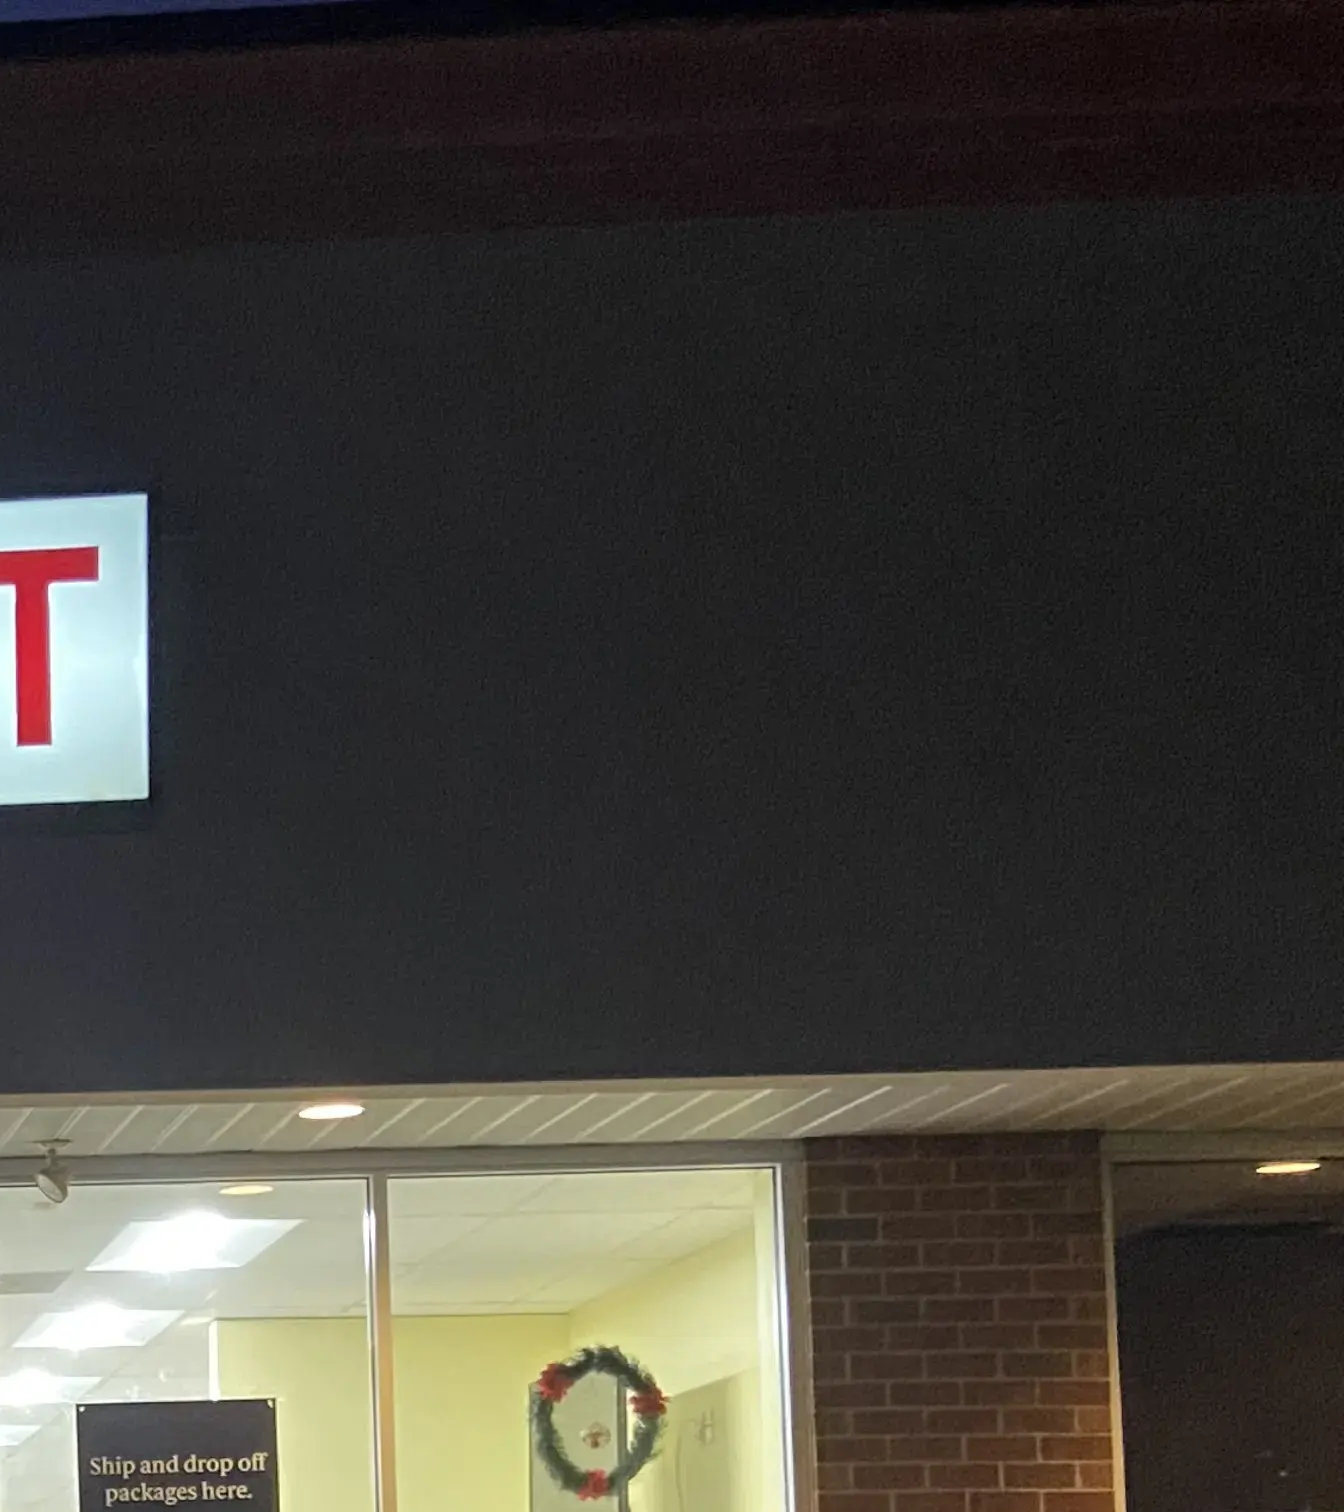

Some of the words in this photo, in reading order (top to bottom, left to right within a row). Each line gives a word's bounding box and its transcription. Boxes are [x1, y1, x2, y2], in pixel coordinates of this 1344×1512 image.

[90, 1456, 136, 1479] Ship
[140, 1454, 180, 1474] and
[183, 1453, 234, 1477] drop
[238, 1452, 269, 1472] off
[104, 1482, 198, 1507] packages
[201, 1481, 254, 1500] here.
